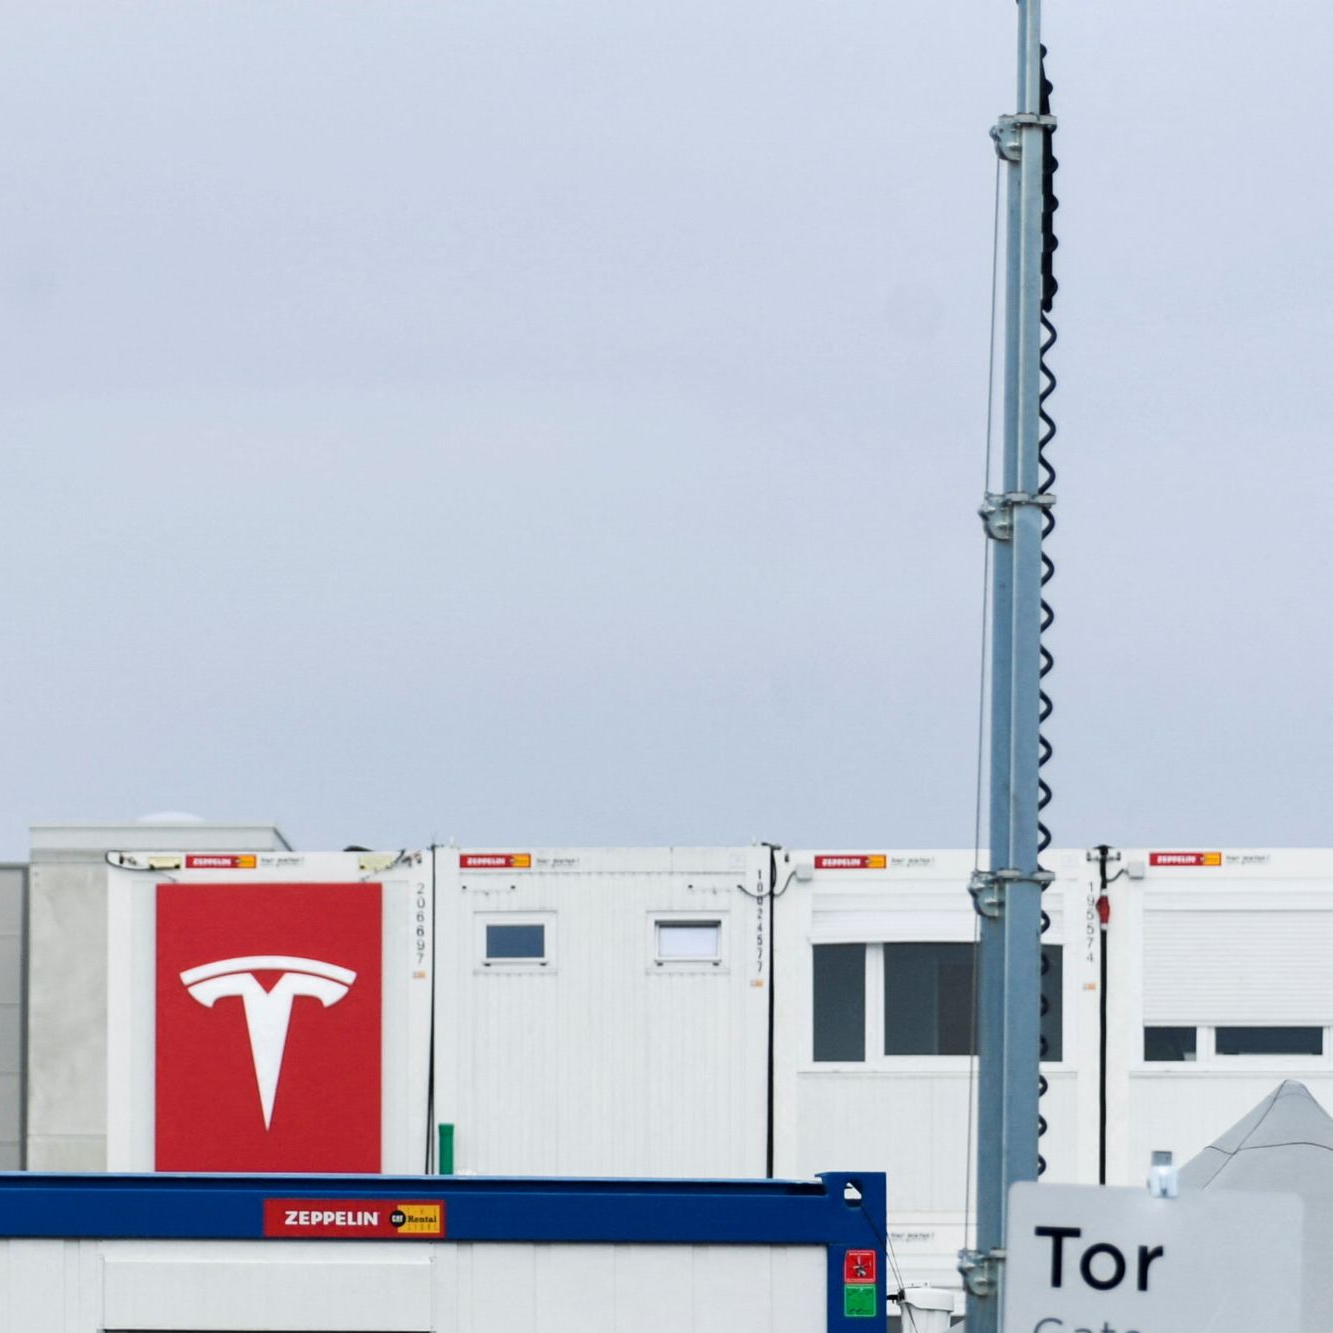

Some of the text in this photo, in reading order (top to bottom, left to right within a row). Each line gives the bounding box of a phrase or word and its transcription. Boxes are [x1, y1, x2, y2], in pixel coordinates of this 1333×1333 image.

[285, 1211, 379, 1226] ZEPPELIN
[407, 1215, 437, 1224] Rental
[1034, 1226, 1164, 1291] Tor
